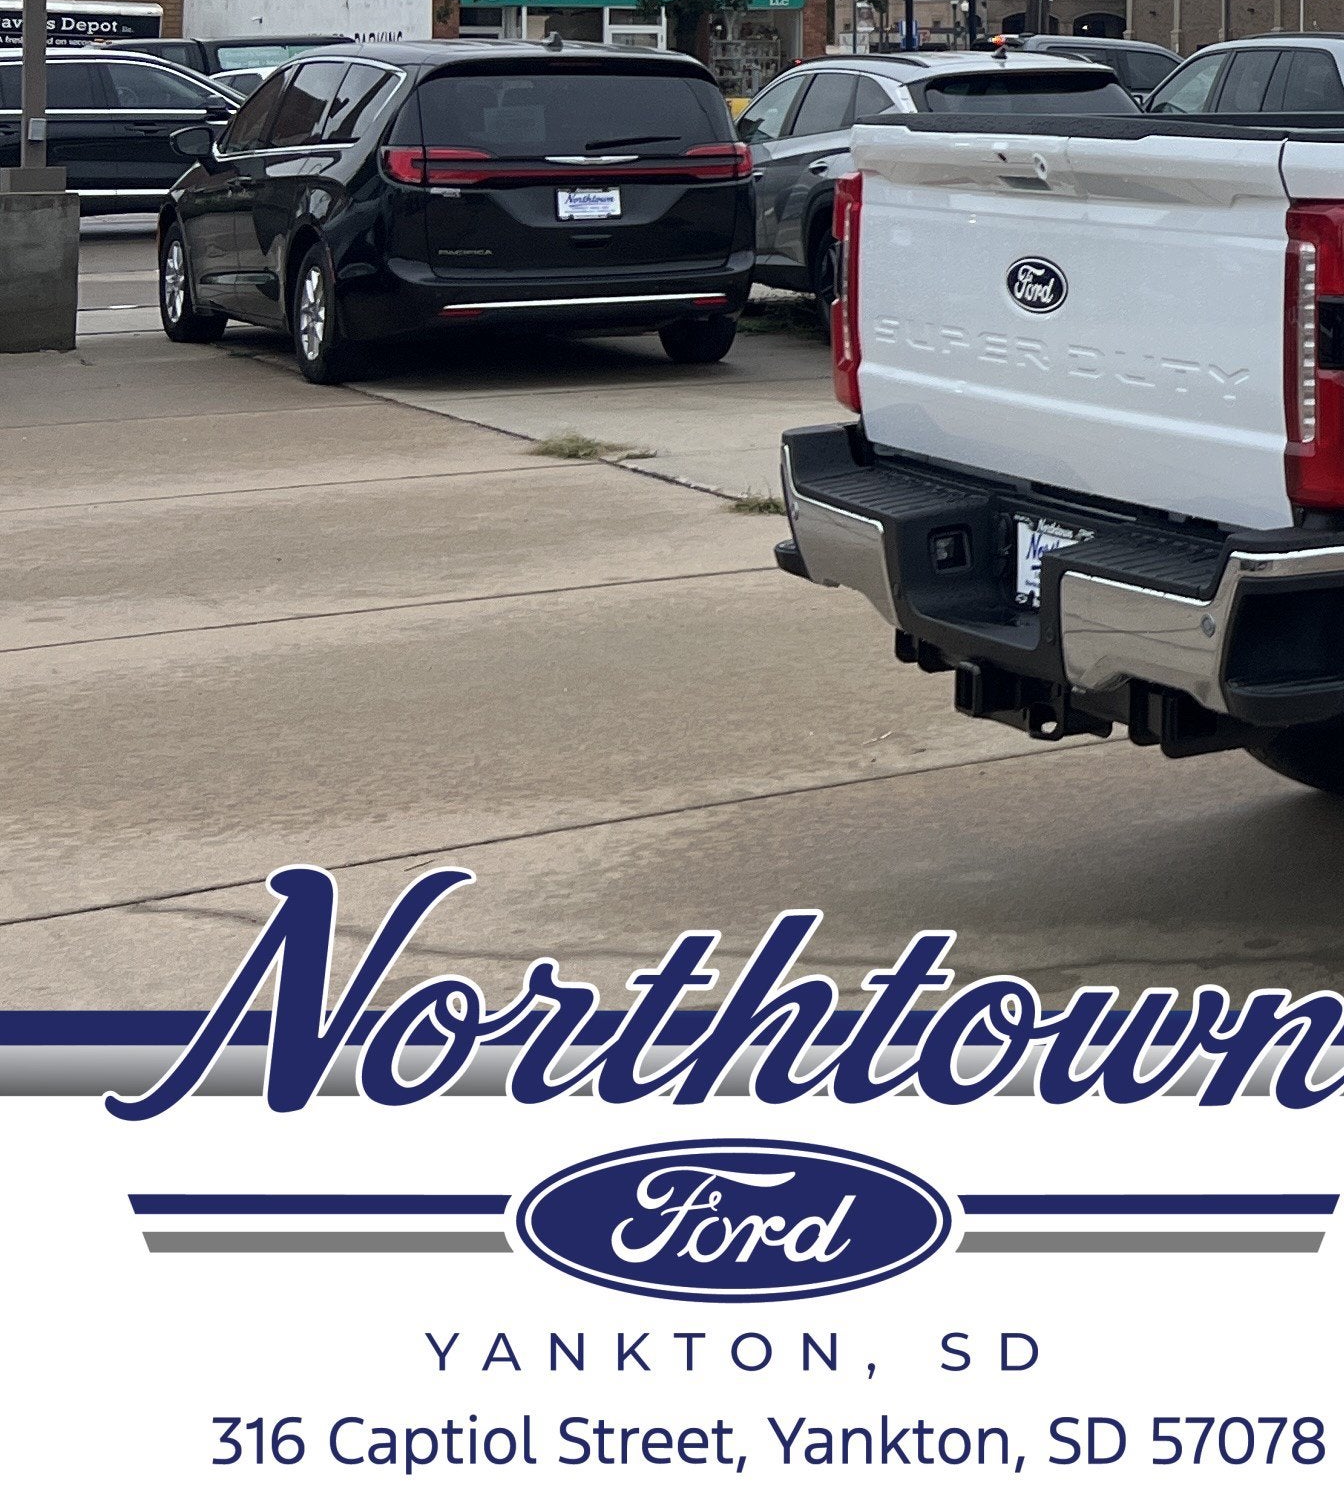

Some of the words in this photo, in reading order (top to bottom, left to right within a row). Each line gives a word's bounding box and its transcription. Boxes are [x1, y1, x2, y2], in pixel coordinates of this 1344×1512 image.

[61, 17, 118, 34] Depot
[1013, 264, 1056, 304] Ford
[873, 318, 1051, 372] SUPER
[1067, 343, 1251, 402] DUTY
